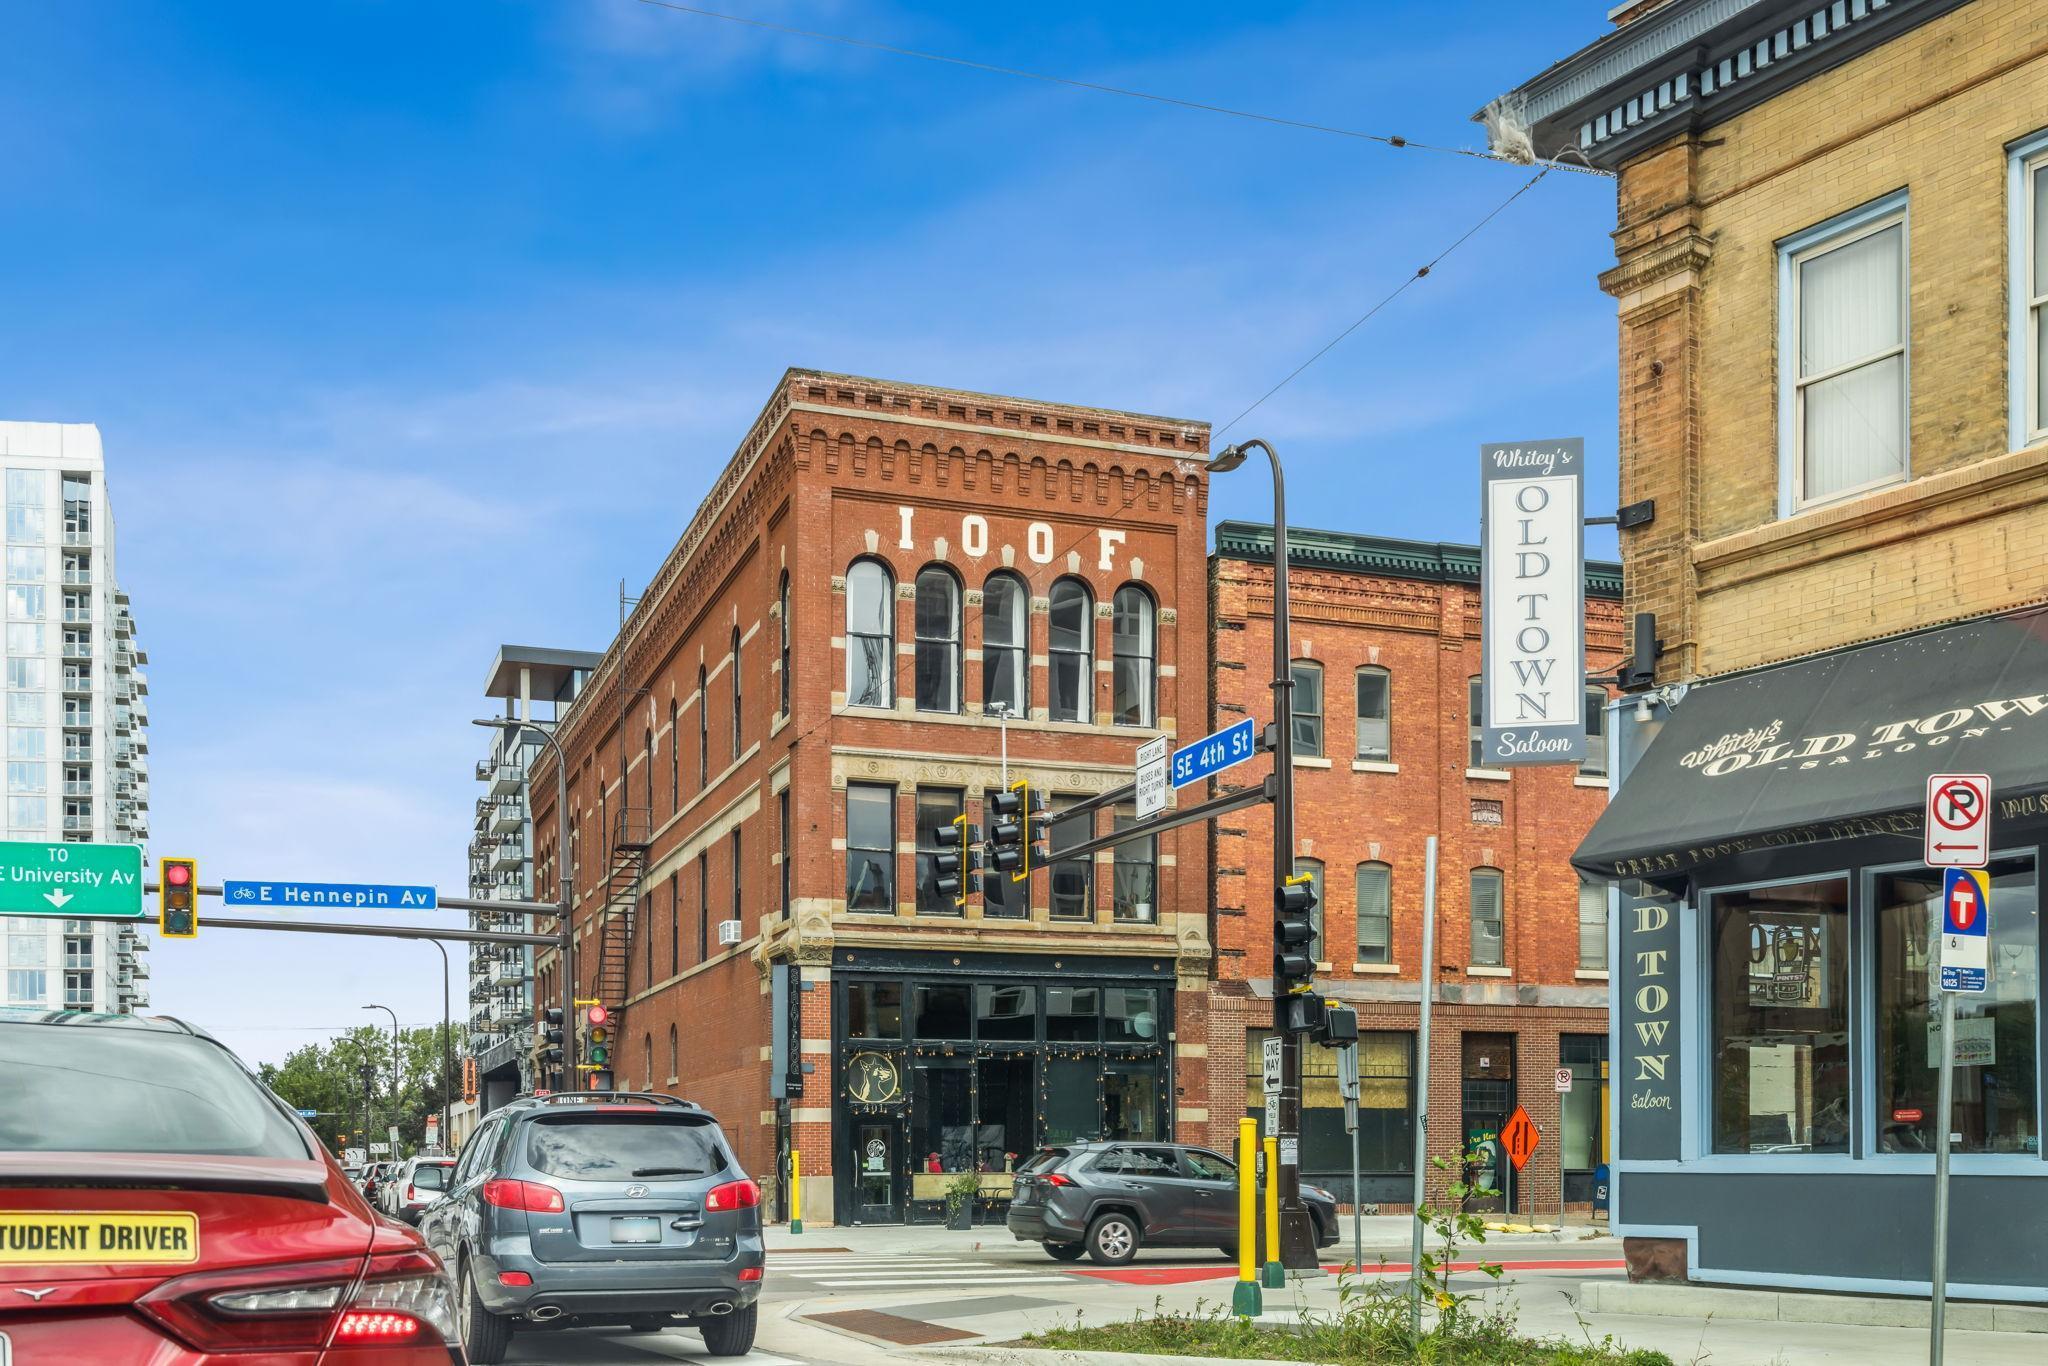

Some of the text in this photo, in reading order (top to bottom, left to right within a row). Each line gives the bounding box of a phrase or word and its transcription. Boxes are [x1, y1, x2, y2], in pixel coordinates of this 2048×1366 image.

[1493, 448, 1573, 475] Whitey's
[1509, 485, 1556, 719] OLD TOWN
[1140, 744, 1163, 762] RIGHT LANE
[1176, 726, 1249, 779] SE 4th St
[1497, 730, 1573, 757] Saloon
[1680, 719, 1784, 768] Whitey's
[1702, 732, 1856, 777] OLD
[1146, 795, 1157, 807] ONLY
[48, 848, 68, 862] TO
[1614, 852, 1680, 877] GREAT
[11, 866, 103, 887] University
[110, 869, 134, 885] Av
[260, 886, 427, 906] E Hennepin Av
[1951, 937, 1957, 948] 6
[1942, 978, 1958, 987] 16125
[1634, 950, 1670, 1081] TOWN
[1265, 1042, 1280, 1056] ONE
[1265, 1058, 1280, 1072] WAY
[863, 1103, 883, 1113] 401
[100, 1223, 188, 1250] DRIVER
